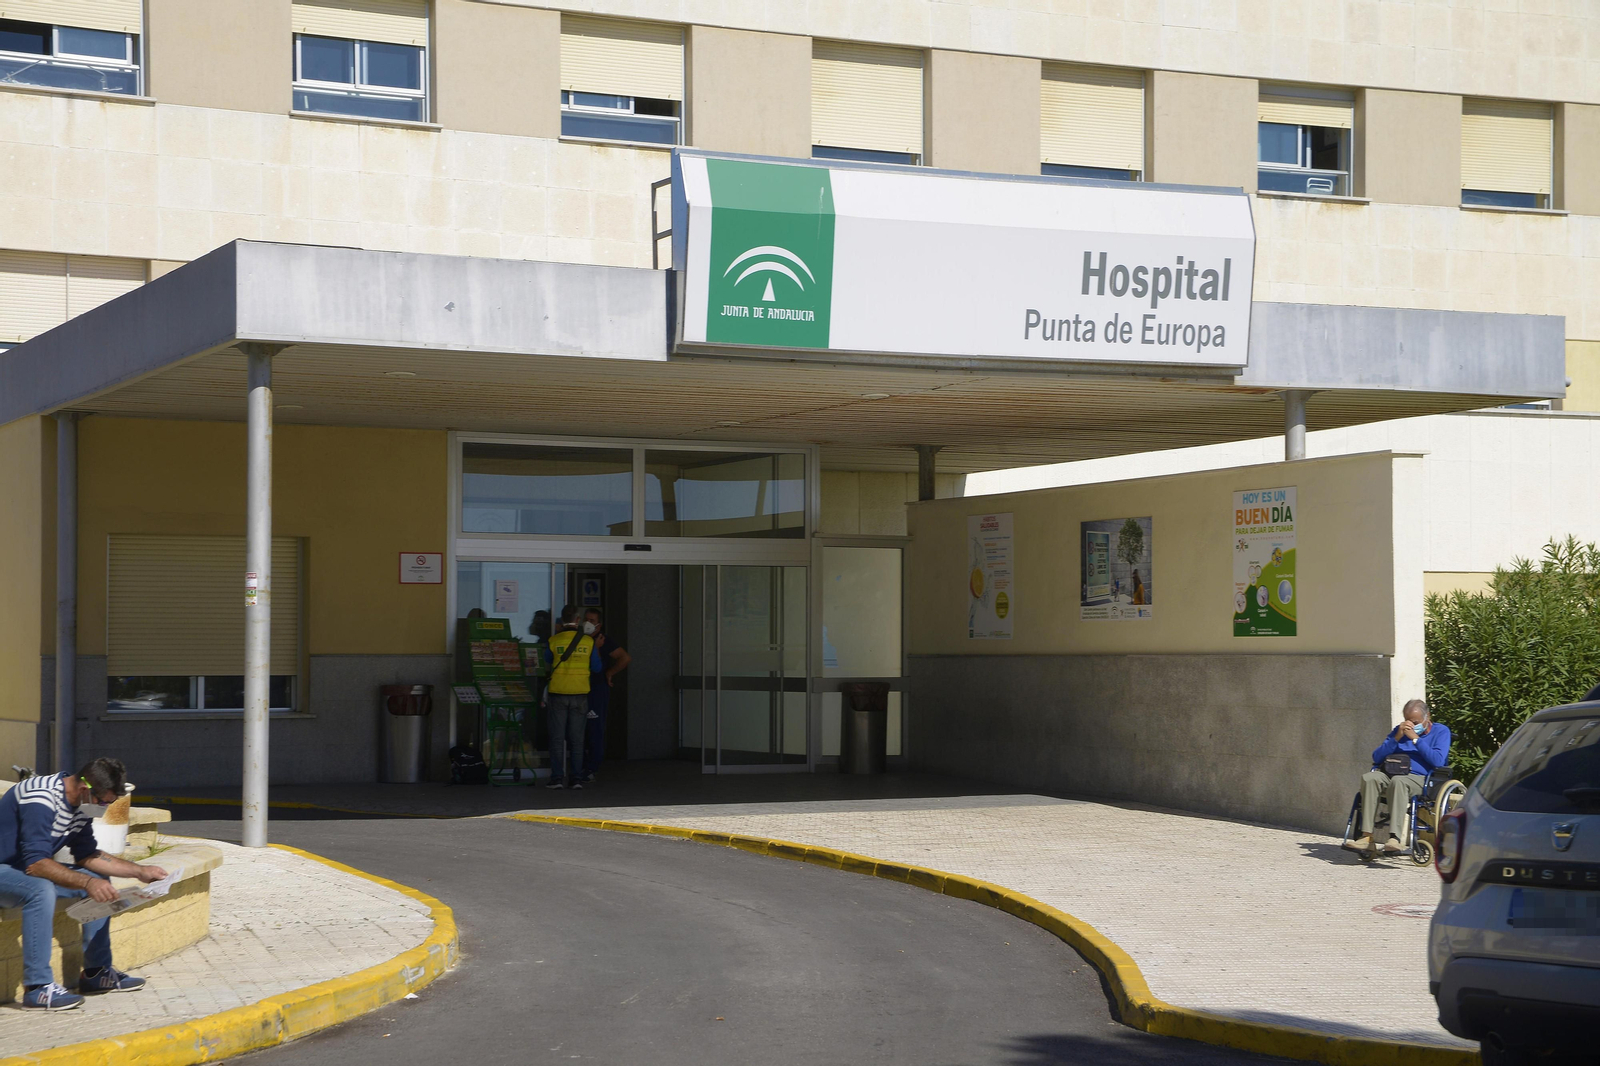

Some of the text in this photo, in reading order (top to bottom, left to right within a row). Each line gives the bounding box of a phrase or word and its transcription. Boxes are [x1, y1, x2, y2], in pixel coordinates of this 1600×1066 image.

[1081, 251, 1231, 309] Hospital
[720, 305, 749, 318] JUNTA
[753, 307, 765, 318] DE
[1024, 309, 1226, 353] Punta de Europa
[1242, 490, 1286, 504] HOY ES UN
[1236, 502, 1293, 526] BUEN DÍA
[1250, 526, 1267, 534] DEJAR
[1268, 525, 1275, 533] DE
[1276, 524, 1294, 532] FUMAR
